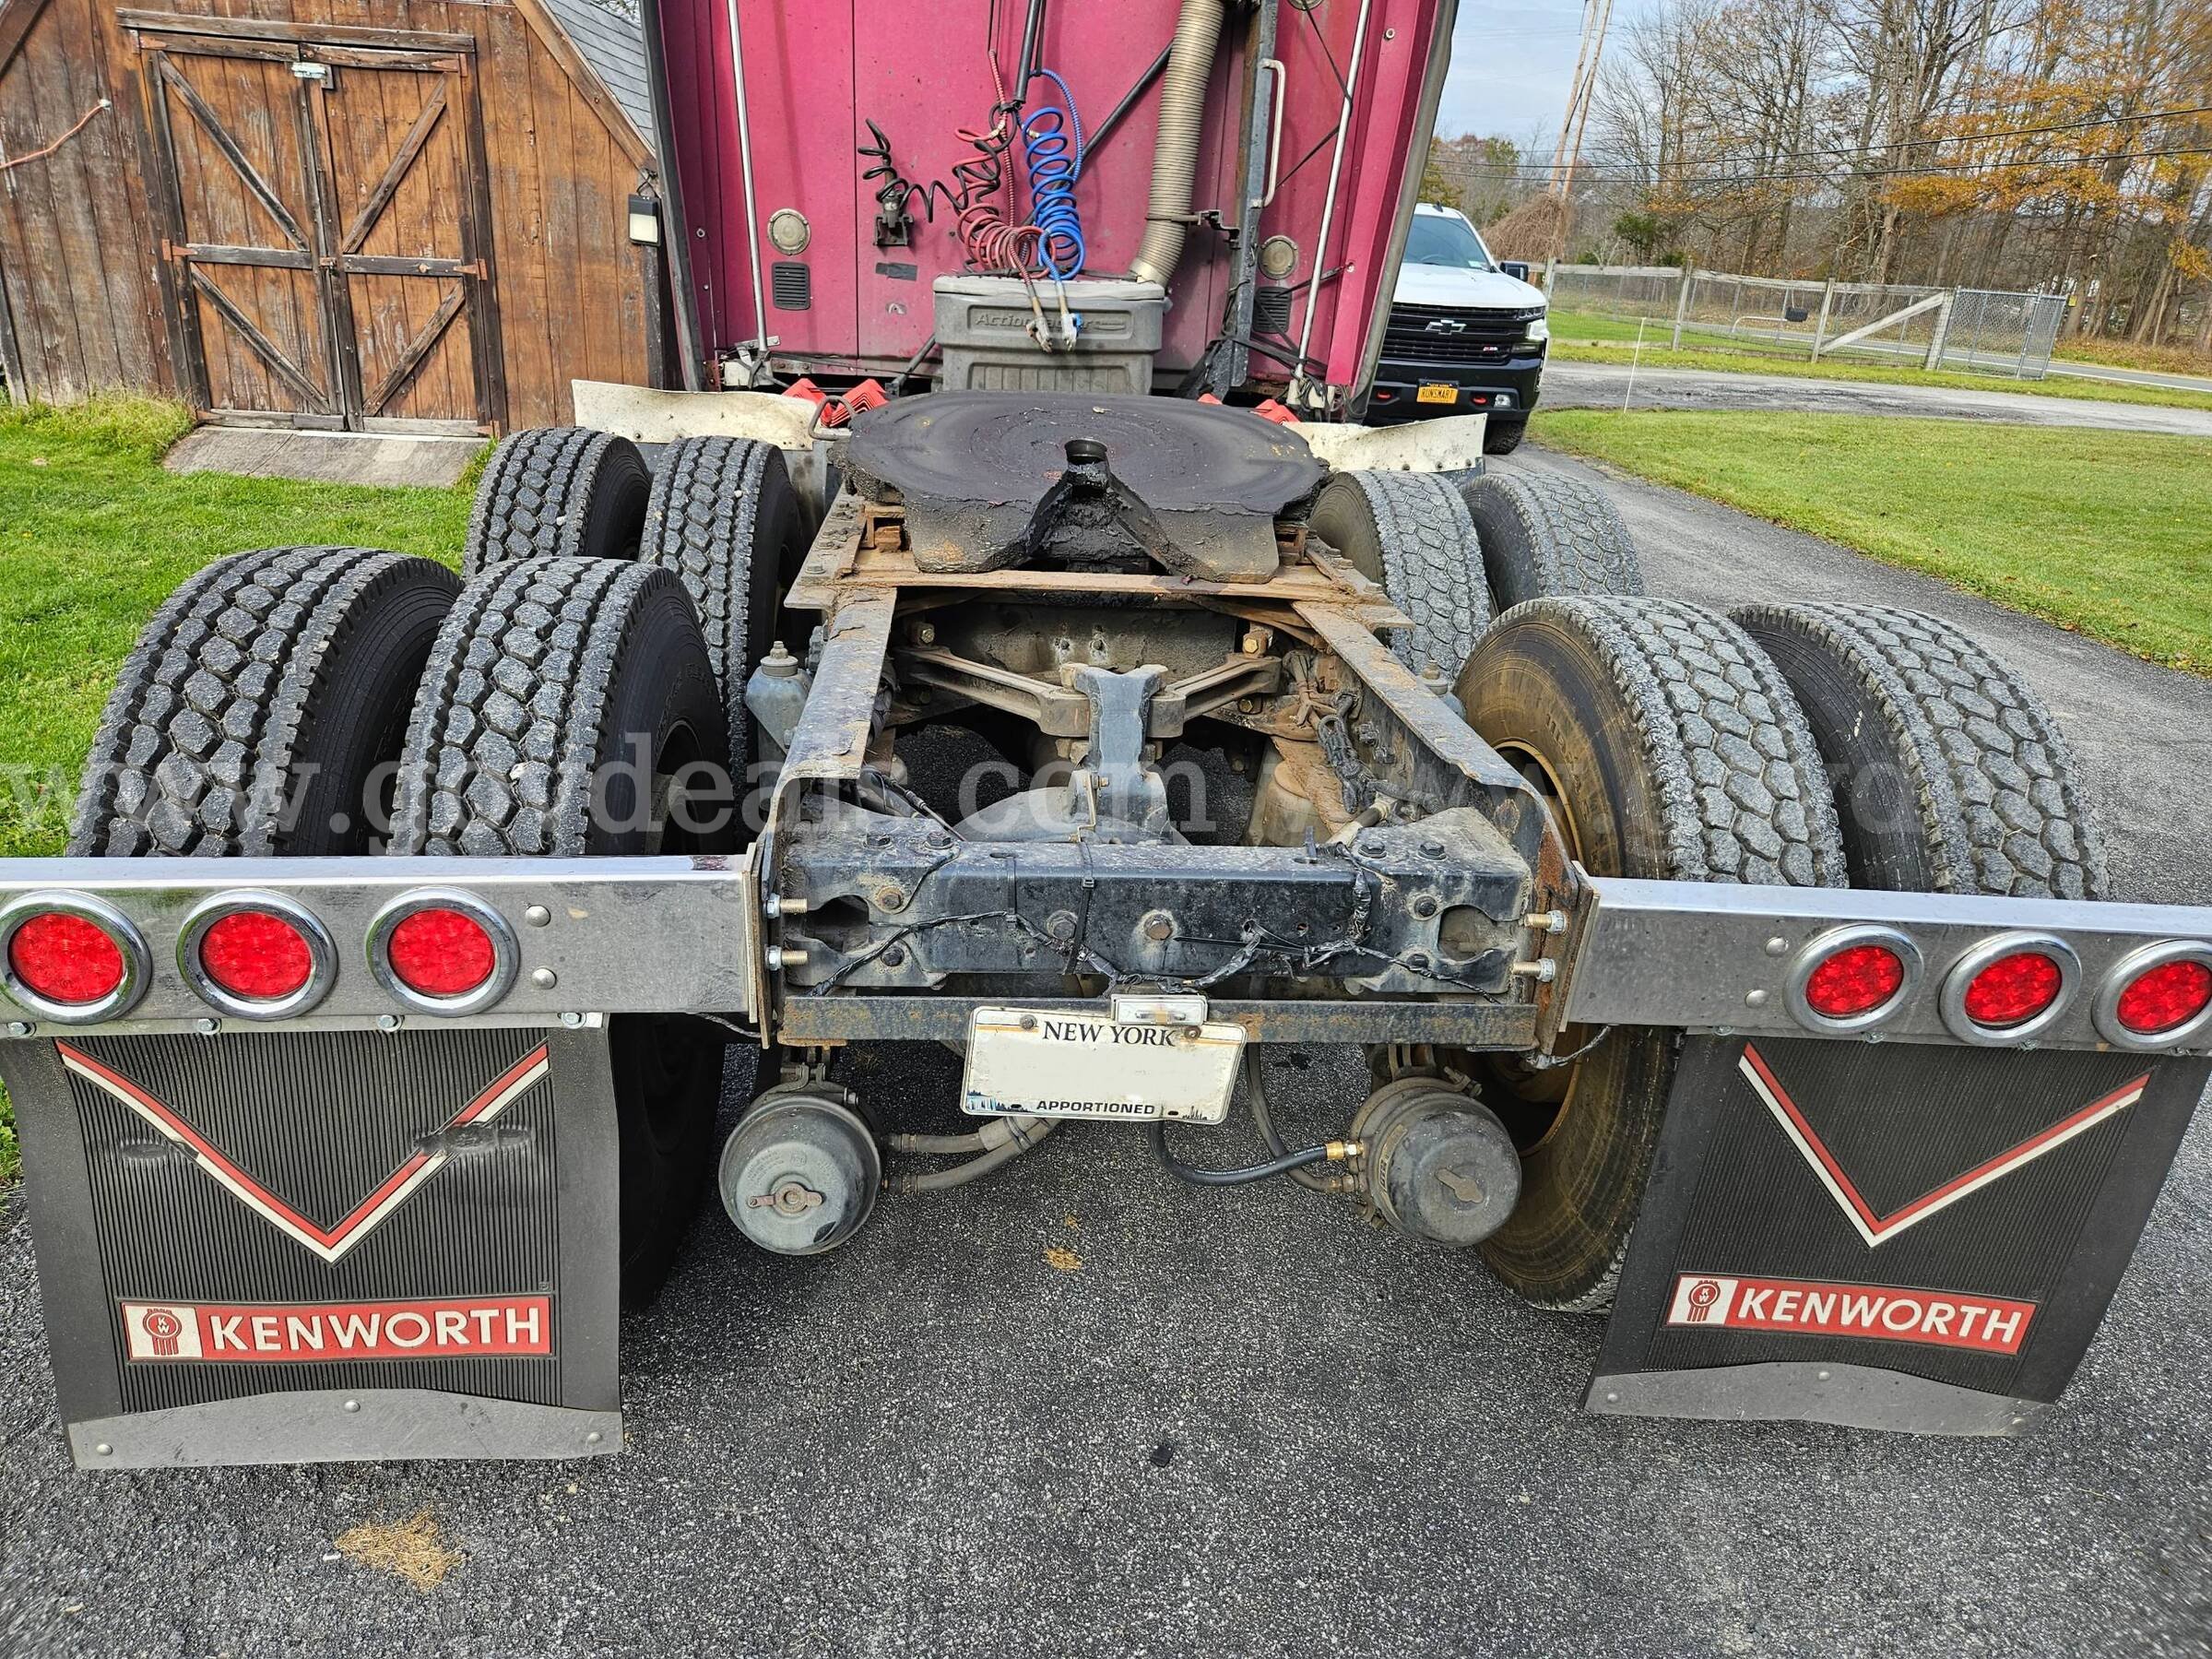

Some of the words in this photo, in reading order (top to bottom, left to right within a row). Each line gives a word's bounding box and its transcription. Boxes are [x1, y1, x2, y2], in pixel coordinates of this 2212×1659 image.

[1043, 1021, 1104, 1042] NEW
[1109, 1025, 1176, 1047] YORK
[1035, 1100, 1155, 1115] APPORTIONED
[208, 1308, 539, 1351] KENWORTH
[1737, 1287, 2022, 1344] KENWORTH
